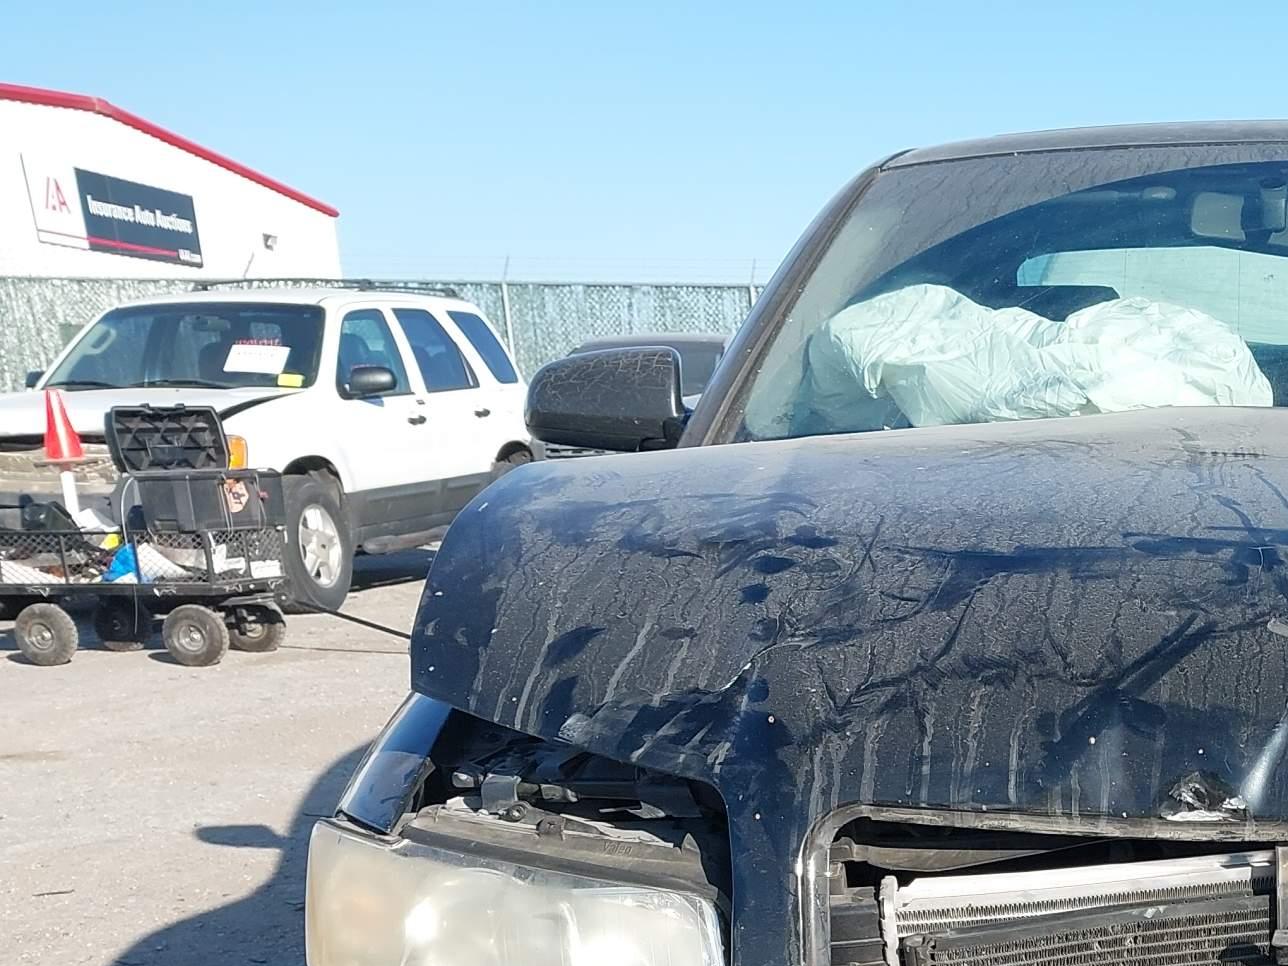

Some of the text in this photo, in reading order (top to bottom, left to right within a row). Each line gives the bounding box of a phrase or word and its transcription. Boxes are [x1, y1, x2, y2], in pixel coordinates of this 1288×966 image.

[86, 194, 193, 234] Insurance Auto Auctions
